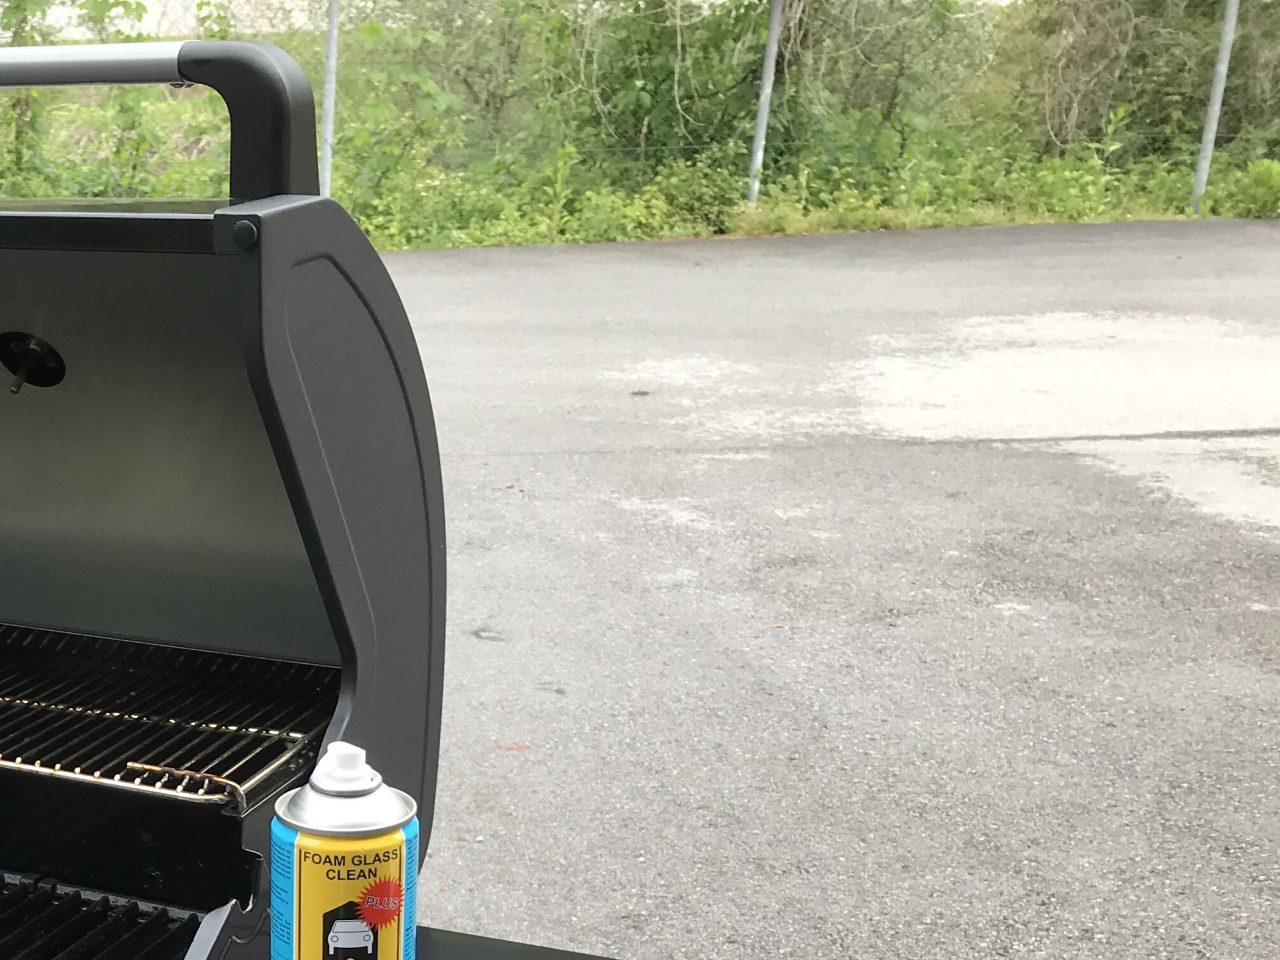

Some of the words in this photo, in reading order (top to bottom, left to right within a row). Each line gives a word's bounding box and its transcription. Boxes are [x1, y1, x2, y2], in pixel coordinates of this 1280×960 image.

[303, 851, 346, 867] FOAM
[351, 849, 398, 867] GLASS
[326, 868, 378, 881] CLEAN
[365, 896, 400, 910] PLUS
